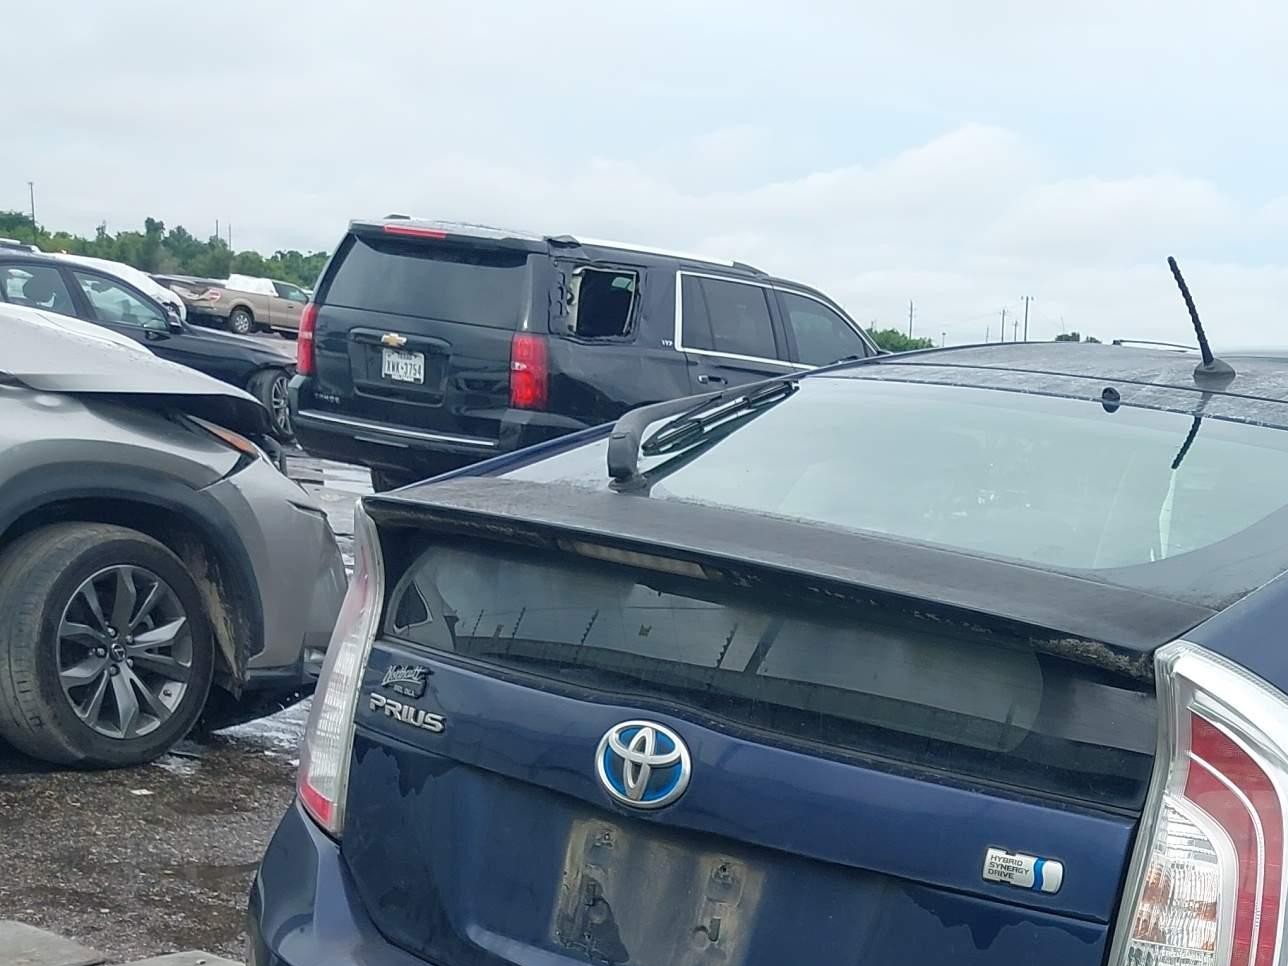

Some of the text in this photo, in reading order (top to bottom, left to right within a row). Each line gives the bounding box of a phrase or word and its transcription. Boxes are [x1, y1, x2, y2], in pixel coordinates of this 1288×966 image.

[369, 692, 447, 733] PRIUS
[990, 854, 1024, 867] HYBRID
[988, 868, 1015, 880] DRIVE
[989, 861, 1030, 875] SYNERGY
